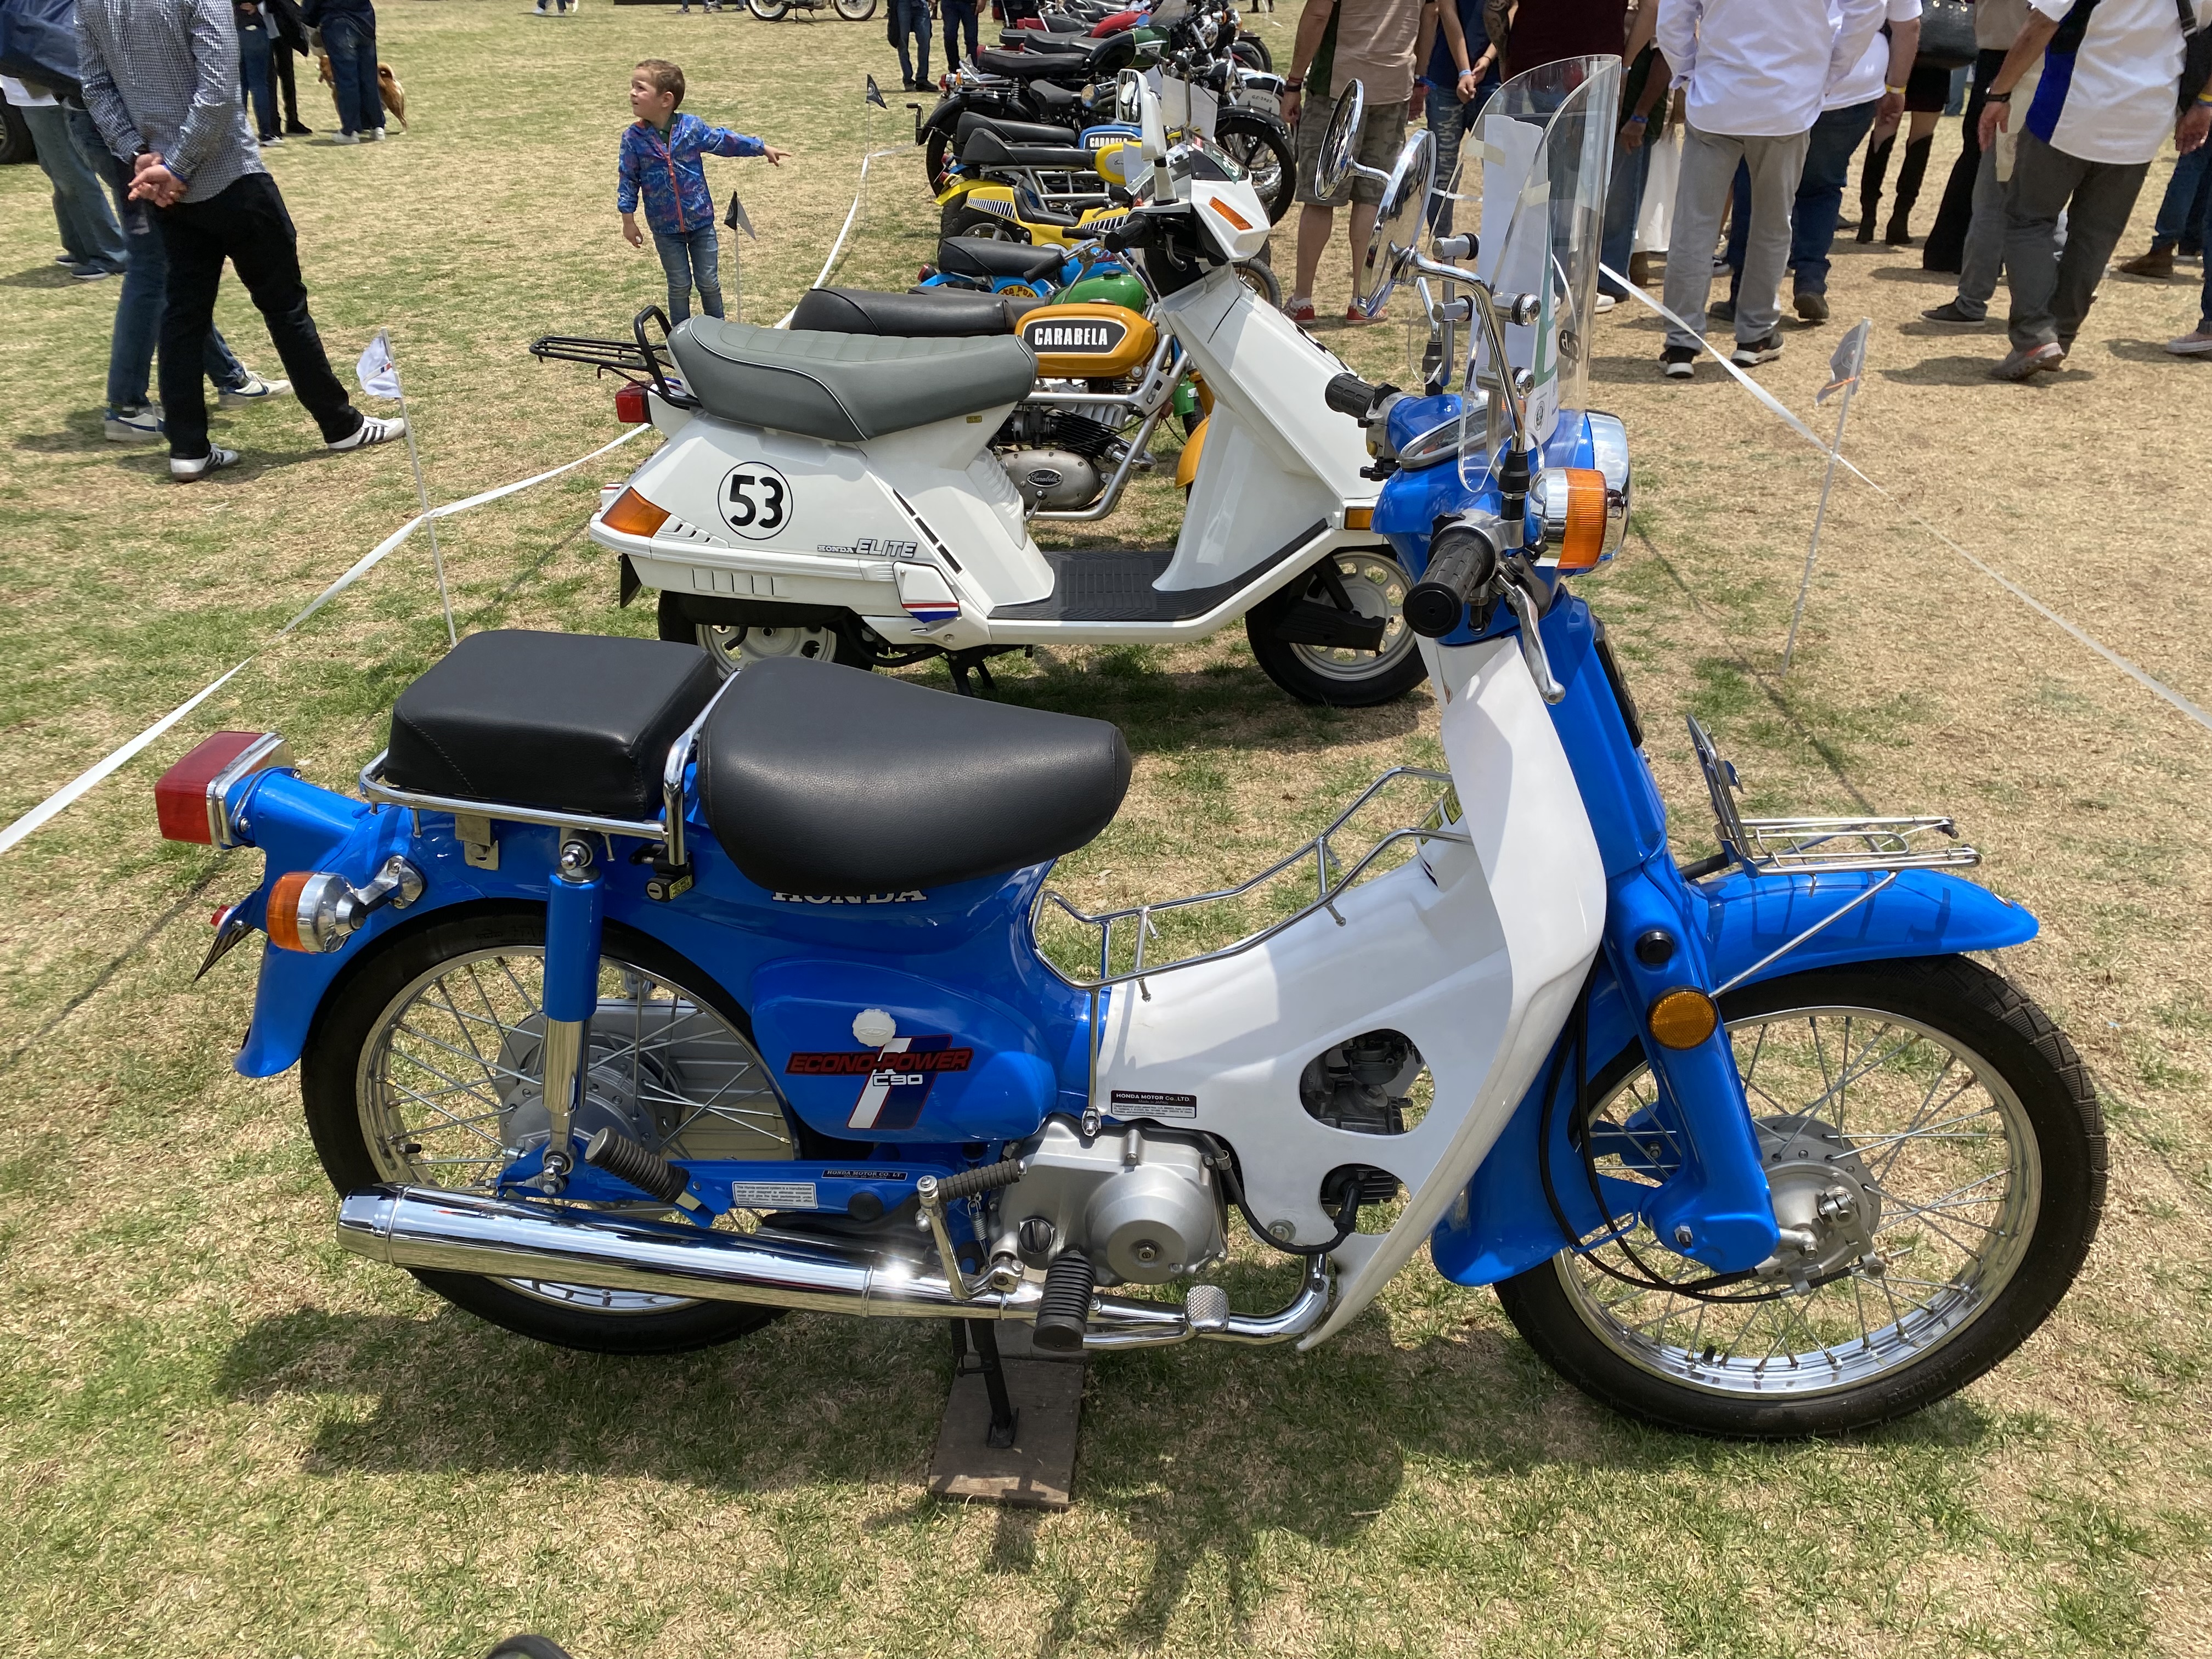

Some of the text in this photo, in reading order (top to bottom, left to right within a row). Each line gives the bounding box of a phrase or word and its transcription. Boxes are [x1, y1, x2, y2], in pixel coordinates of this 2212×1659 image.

[1034, 328, 1108, 345] CARABELA
[1031, 473, 1058, 482] Carabela
[729, 475, 783, 528] 53
[817, 538, 917, 558] HONDA ELITE
[791, 1051, 970, 1071] ECONO-POWER
[873, 1074, 923, 1086] C90
